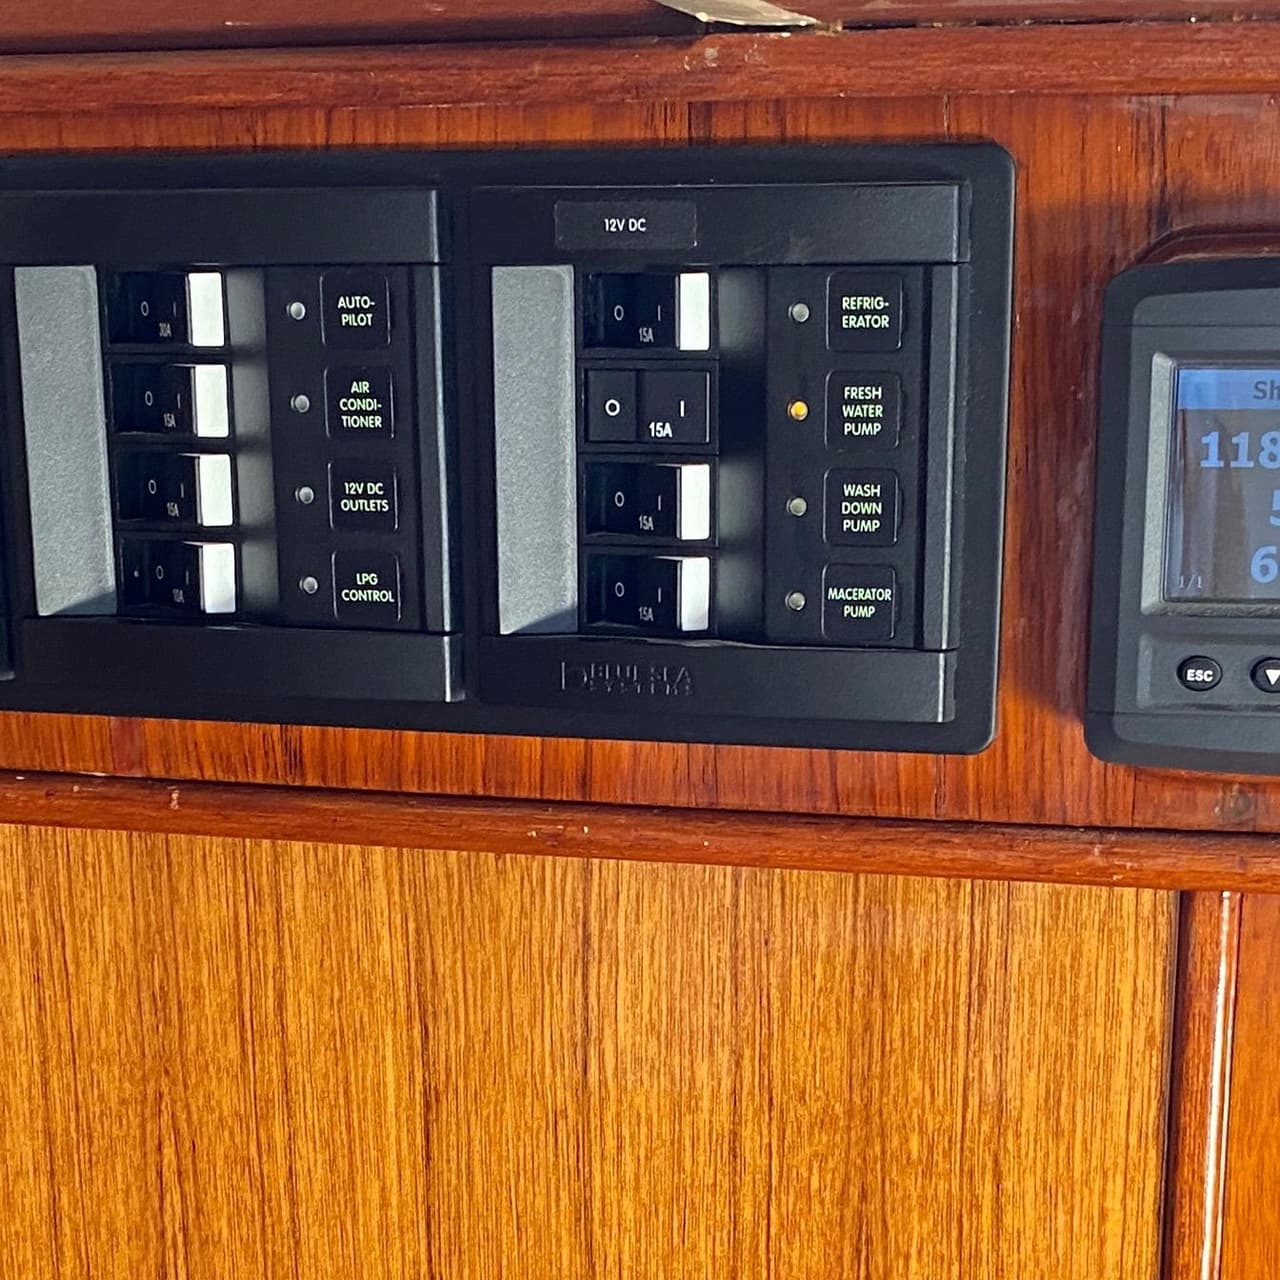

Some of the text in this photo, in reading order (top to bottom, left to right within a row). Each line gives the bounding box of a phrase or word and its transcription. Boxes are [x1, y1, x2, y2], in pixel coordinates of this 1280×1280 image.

[604, 218, 647, 233] 12V DC
[337, 296, 375, 309] AUTO-
[842, 296, 889, 310] REFRIG-
[341, 313, 373, 326] PILOT
[842, 315, 889, 329] ERATOR
[639, 327, 654, 343] 15A
[350, 381, 370, 393] AIR
[844, 386, 882, 400] FRESH
[339, 398, 382, 411] CONDI-
[842, 405, 883, 418] WATER
[341, 415, 382, 428] TIONER
[649, 421, 673, 438] 15A
[844, 423, 882, 436] PUMP
[344, 482, 384, 495] 12V DC
[843, 484, 881, 497] WASH
[340, 499, 389, 512] OUTLETS
[841, 502, 882, 515] DOWN
[638, 515, 654, 531] 15A
[843, 520, 880, 532] PUMP
[356, 573, 378, 585] LPG
[1178, 574, 1204, 590] 1/1
[341, 589, 395, 602] CONTROL
[827, 587, 892, 601] MACERATOR
[638, 606, 654, 622] 15A
[844, 606, 875, 618] PUMP
[1187, 669, 1213, 682] ESC
